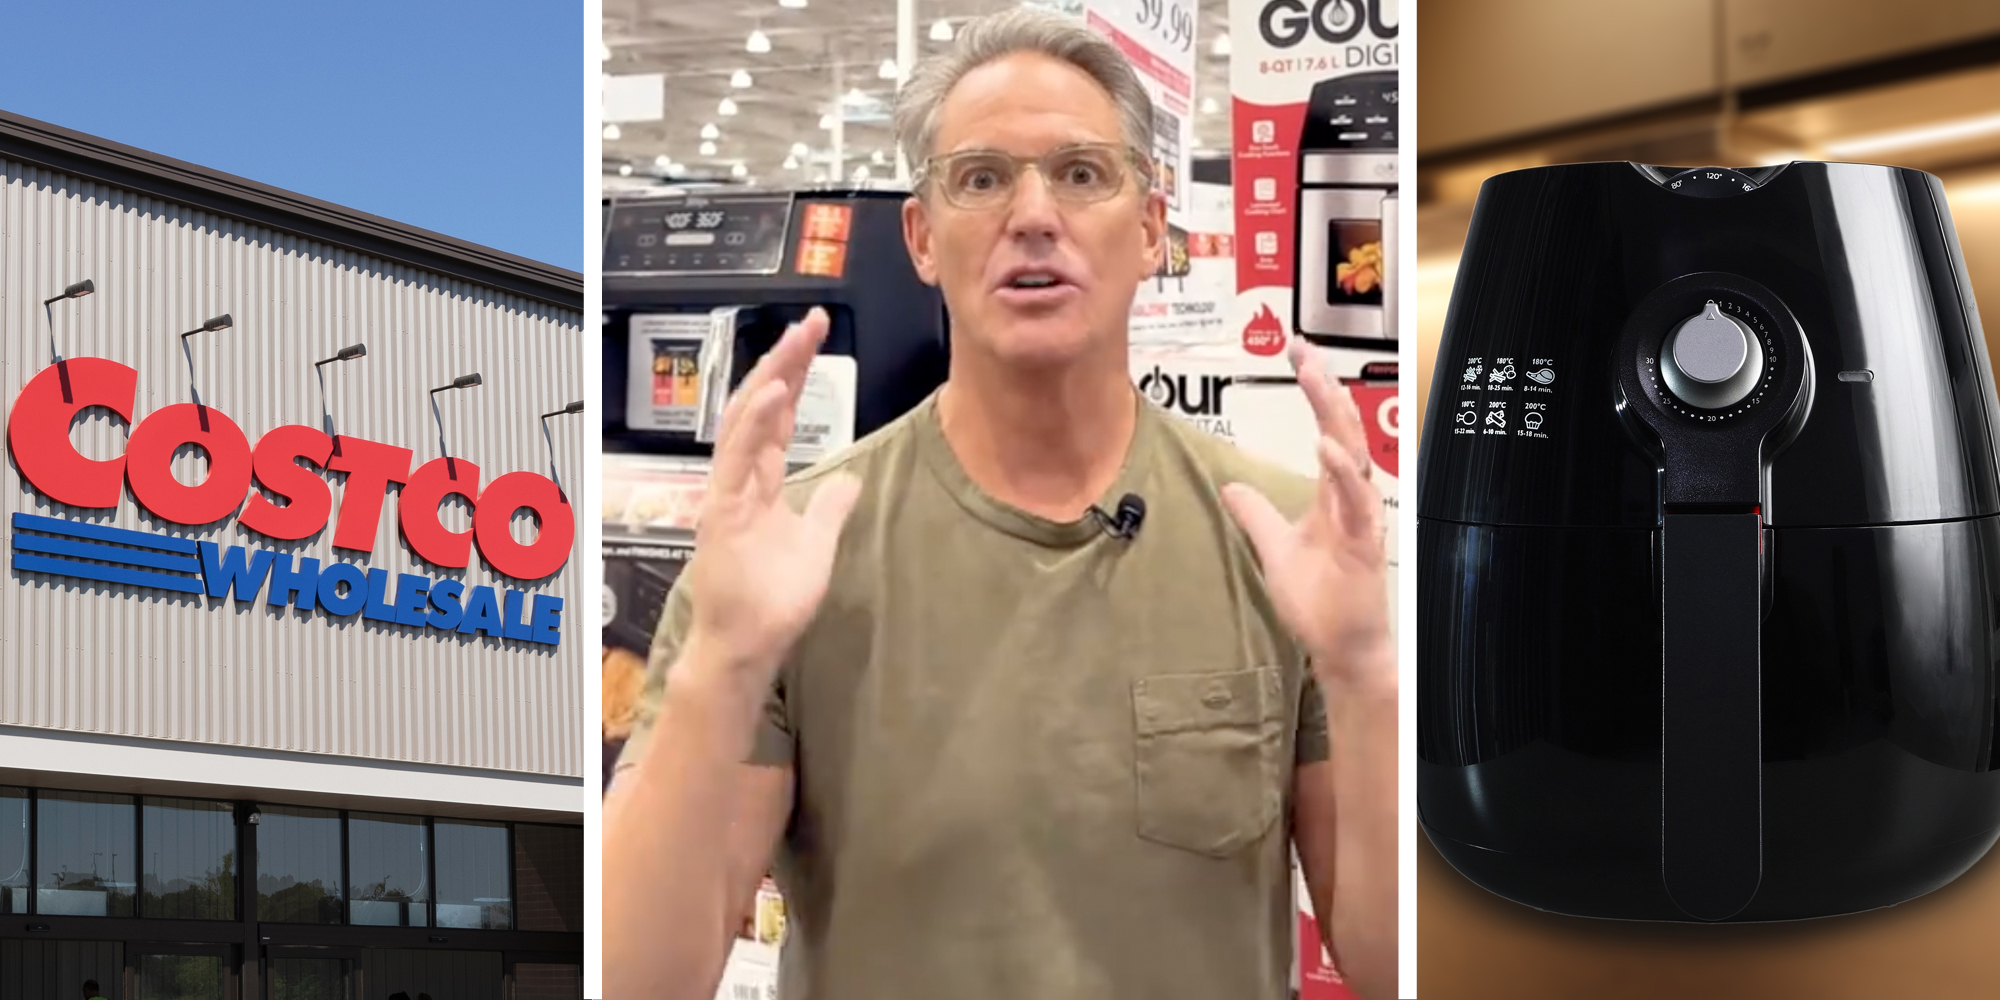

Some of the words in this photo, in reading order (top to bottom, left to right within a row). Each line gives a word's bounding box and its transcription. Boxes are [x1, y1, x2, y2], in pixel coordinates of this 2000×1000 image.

[1260, 60, 1292, 73] 8-QT
[1305, 57, 1327, 71] 7.6
[1706, 172, 1722, 180] 120°
[1670, 179, 1683, 190] 80°
[1728, 302, 1733, 310] 2
[1745, 310, 1750, 318] 4
[1753, 316, 1758, 324] 5
[1767, 338, 1772, 346] 8
[1532, 358, 1553, 366] 180°C
[1645, 357, 1654, 365] 30
[1537, 386, 1553, 394] min.
[1488, 401, 1507, 409] 200°C
[1525, 402, 1547, 411] 200°C
[1517, 429, 1533, 438] 15-18
[1533, 430, 1549, 439] min.
[8, 356, 576, 580] COSTCO
[197, 539, 565, 646] WHOLESALE
